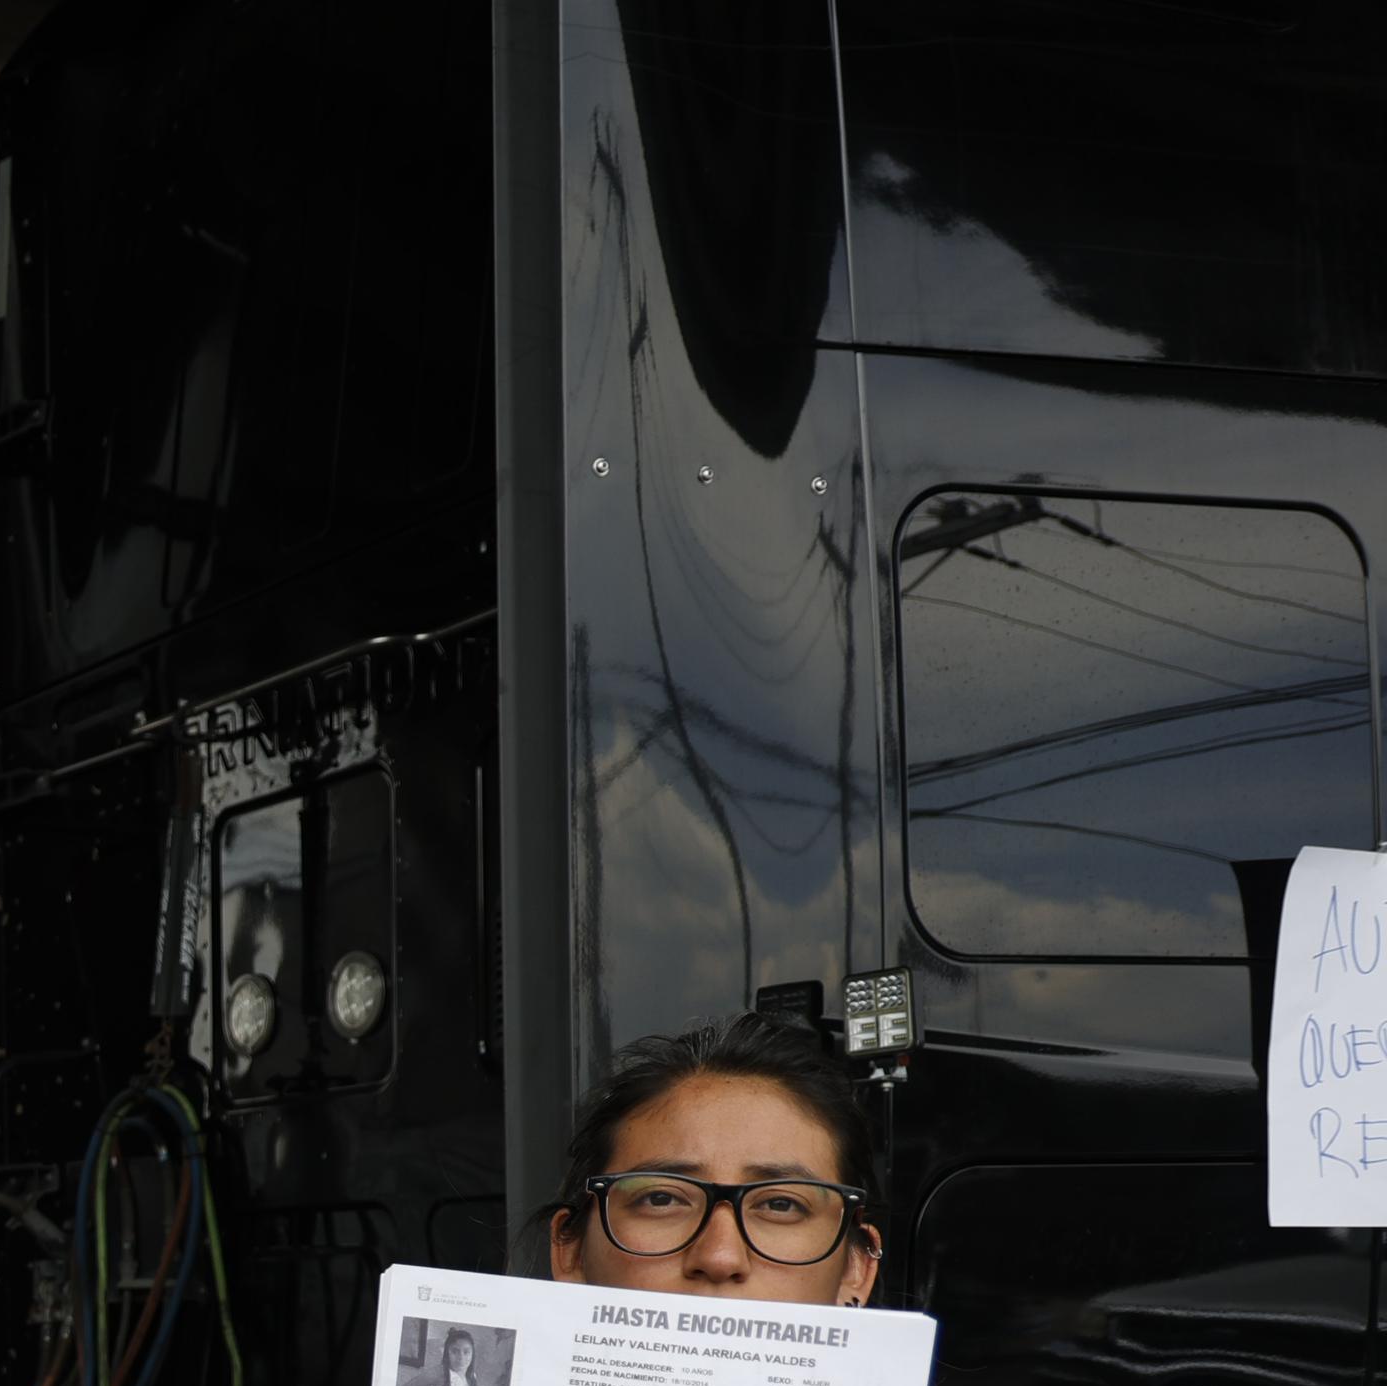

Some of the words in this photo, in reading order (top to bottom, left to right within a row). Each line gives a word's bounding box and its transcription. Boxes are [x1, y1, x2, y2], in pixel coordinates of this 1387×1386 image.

[1313, 885, 1387, 993] AU
[592, 1303, 671, 1332] ¡HASTA
[676, 1312, 849, 1349] ENCONTRARLE!
[574, 1333, 626, 1349] LEILANY
[628, 1339, 699, 1357] VALENTINA
[702, 1347, 761, 1363] ARRIAGA
[764, 1353, 817, 1368] VALDES
